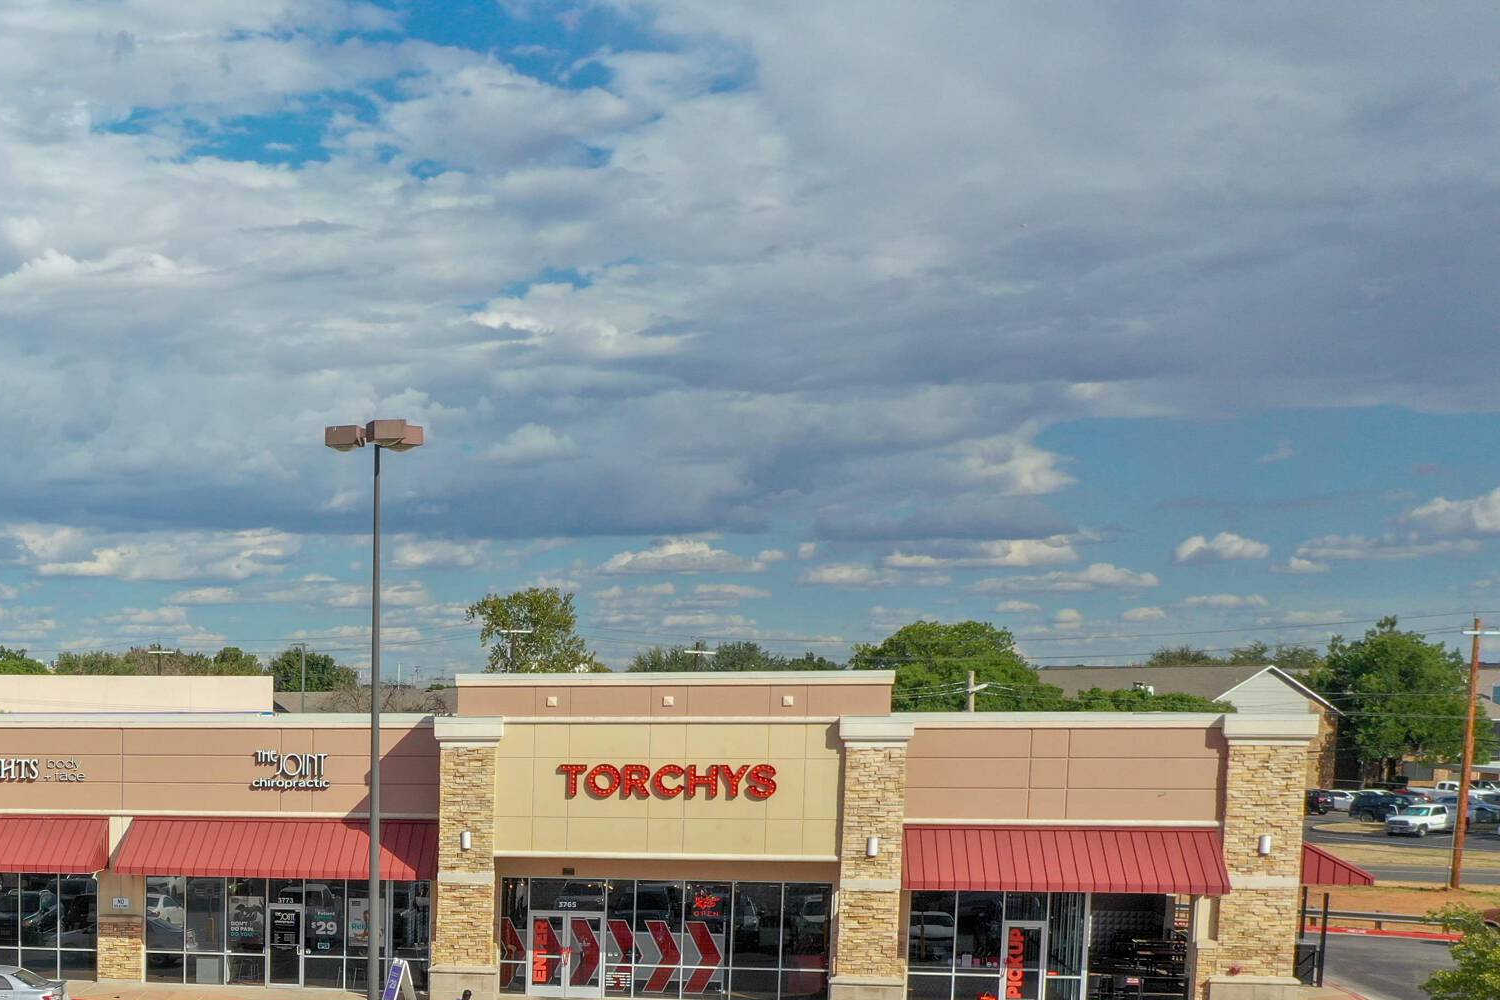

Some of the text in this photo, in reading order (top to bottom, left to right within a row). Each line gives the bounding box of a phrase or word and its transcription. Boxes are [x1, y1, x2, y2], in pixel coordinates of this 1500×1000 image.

[46, 756, 82, 772] body
[255, 750, 328, 776] THE JOINT
[53, 771, 86, 783] face
[252, 777, 331, 790] chiropractic
[558, 763, 778, 799] TORCHYS
[310, 920, 338, 936] $29
[532, 920, 549, 983] ENTER
[1006, 927, 1025, 999] PICKUP
